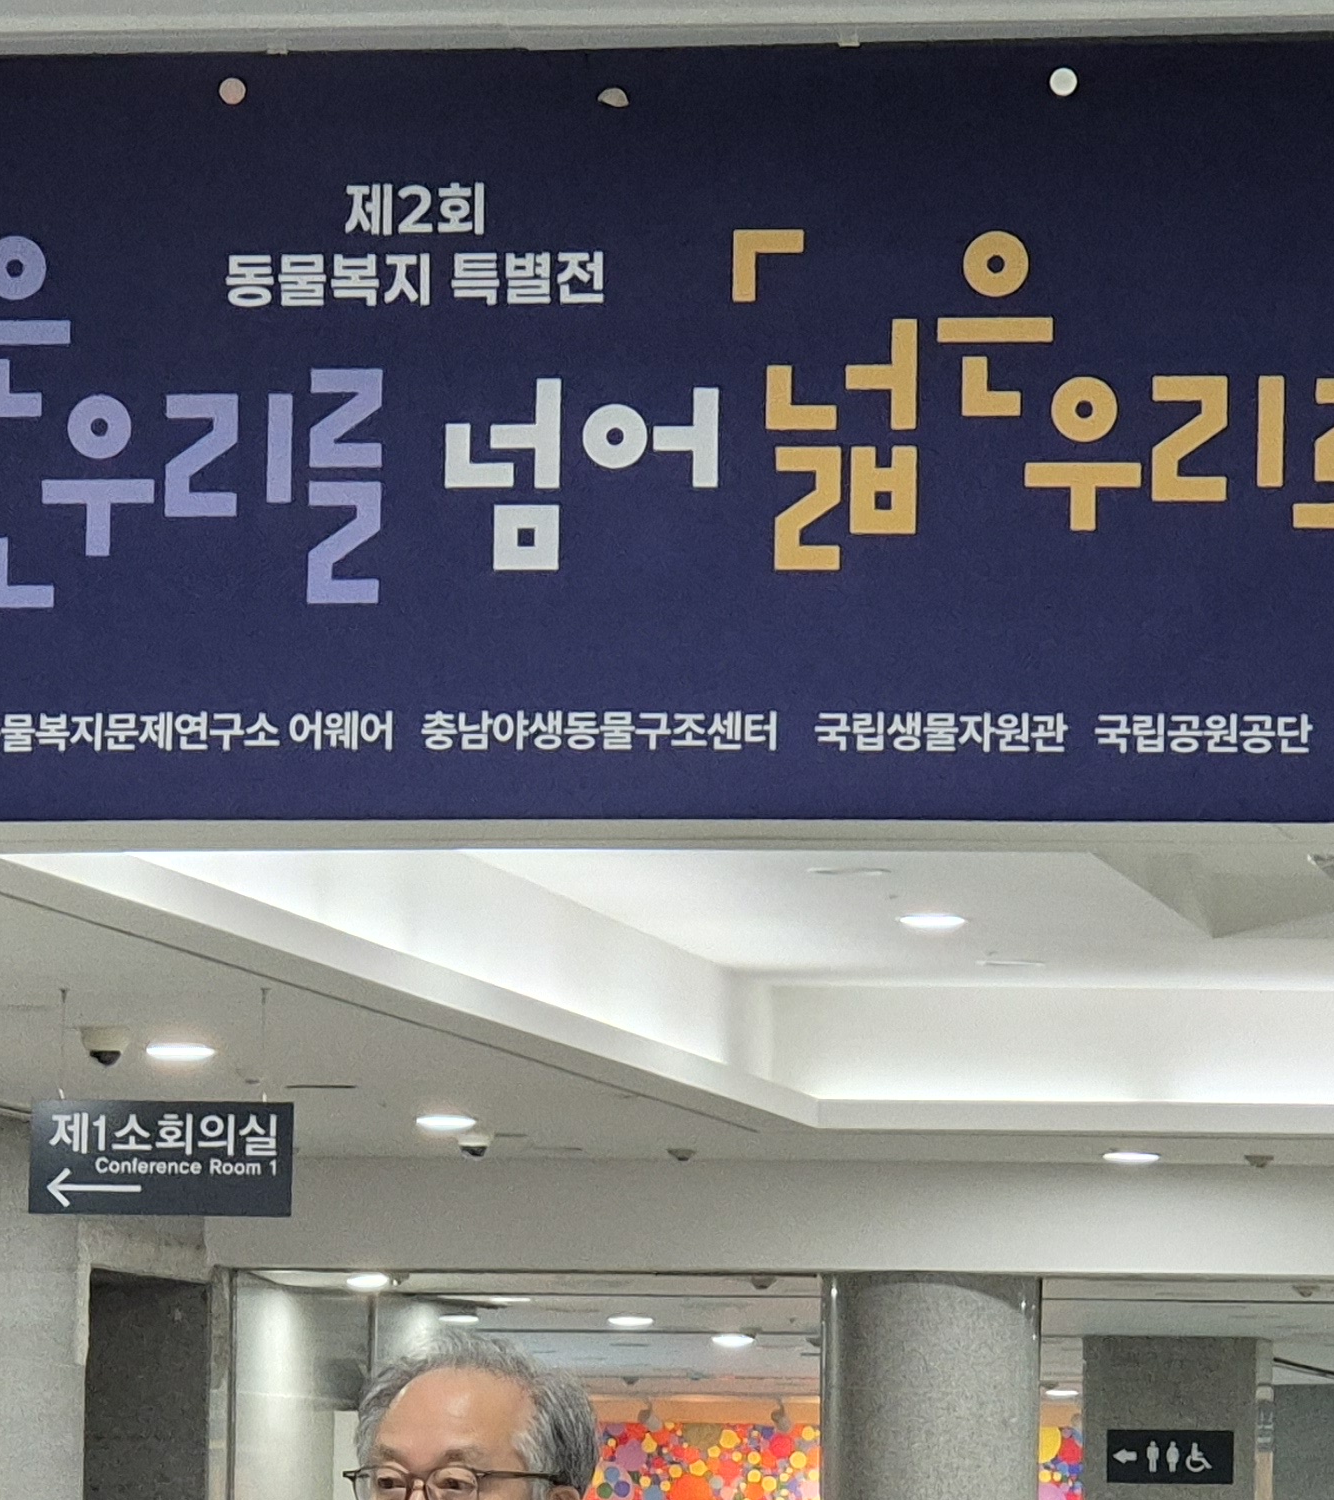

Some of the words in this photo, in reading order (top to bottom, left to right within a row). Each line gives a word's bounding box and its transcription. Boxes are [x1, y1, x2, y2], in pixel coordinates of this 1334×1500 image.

[345, 182, 485, 236] 제2회
[225, 253, 431, 308] 동물복지
[451, 251, 604, 306] 특별전
[42, 368, 384, 605] 우리를
[444, 378, 719, 571] 넘어
[289, 710, 393, 751] 어웨어
[420, 710, 778, 752] 충남야생동물구조센터
[814, 711, 1069, 753] 국립생물자원관
[1094, 713, 1313, 754] 국립공원공단
[48, 1111, 278, 1157] 제1소회의실
[95, 1157, 202, 1176] Conference
[210, 1158, 262, 1176] Room
[269, 1158, 277, 1176] 1
